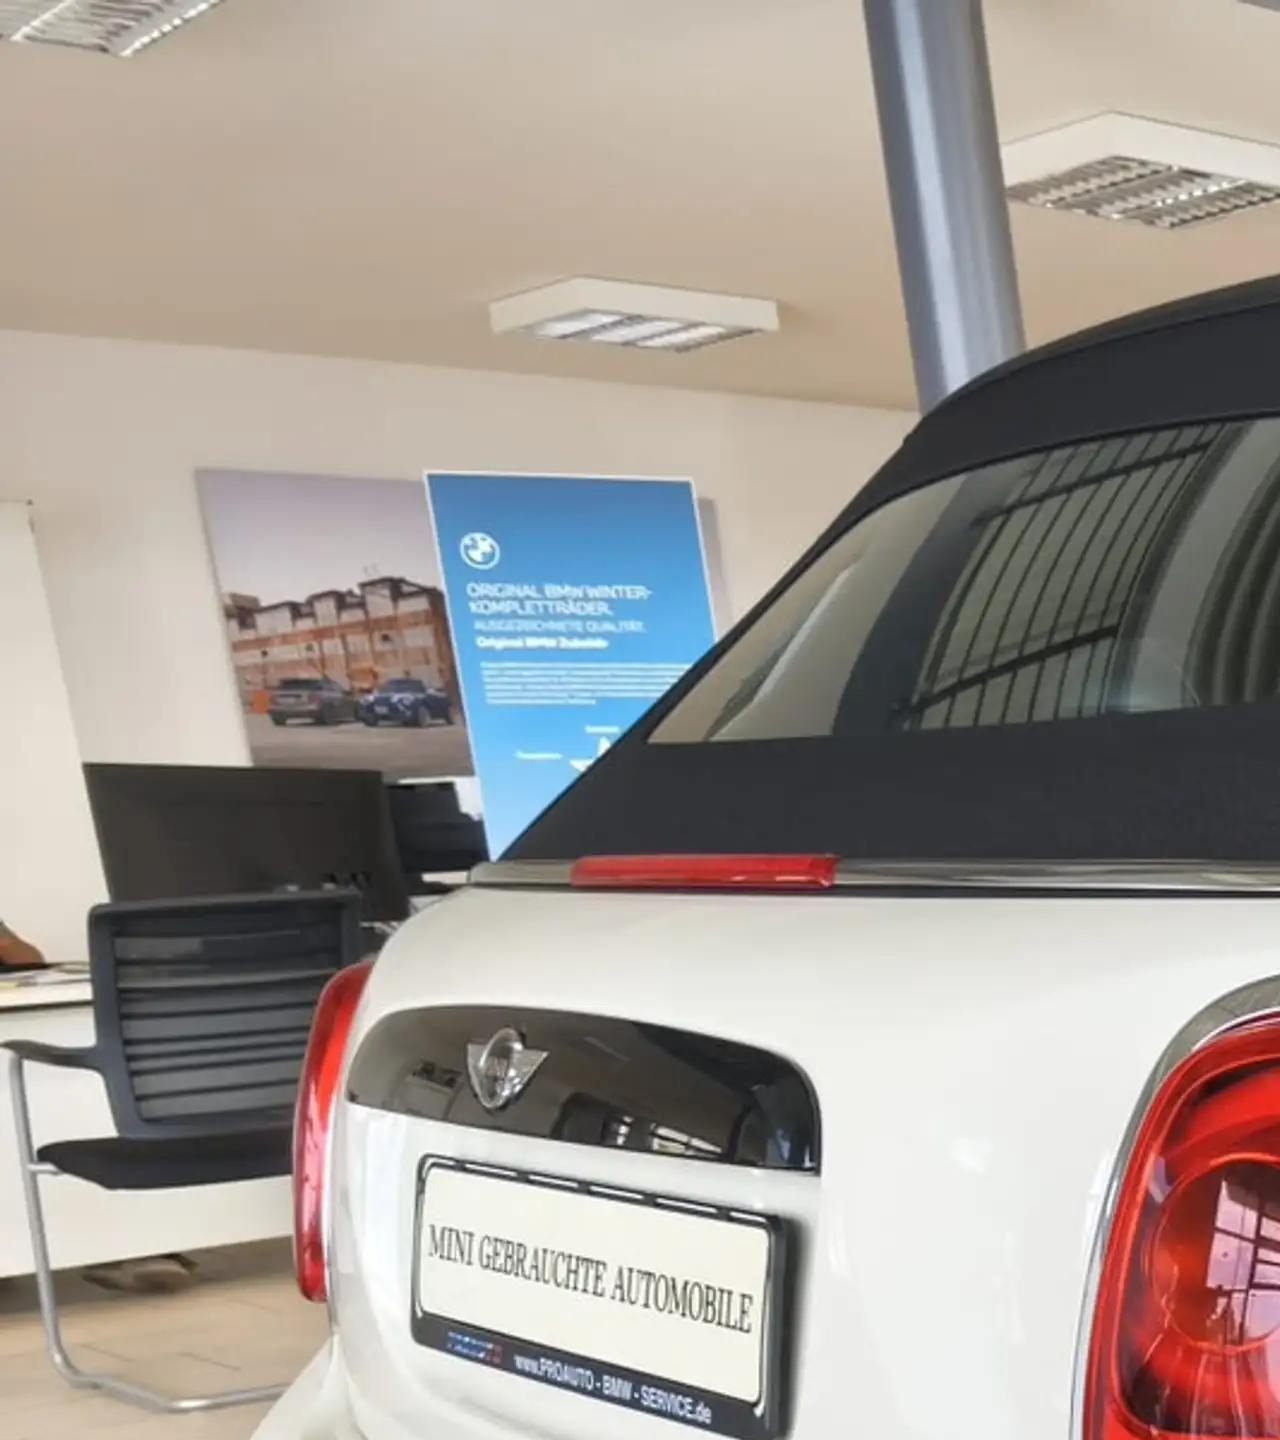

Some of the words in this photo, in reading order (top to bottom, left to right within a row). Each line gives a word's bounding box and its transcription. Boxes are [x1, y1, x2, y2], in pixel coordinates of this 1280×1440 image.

[466, 582, 543, 598] ORIGINAL
[544, 583, 585, 599] BMW
[428, 1224, 474, 1265] MINI
[479, 1235, 607, 1297] GEBRAUCHTE
[610, 1265, 753, 1333] AUTOMOBILE
[514, 1354, 593, 1390] www.PROAUTO
[602, 1374, 633, 1401] BMW
[640, 1385, 712, 1424] SERVICE.de
